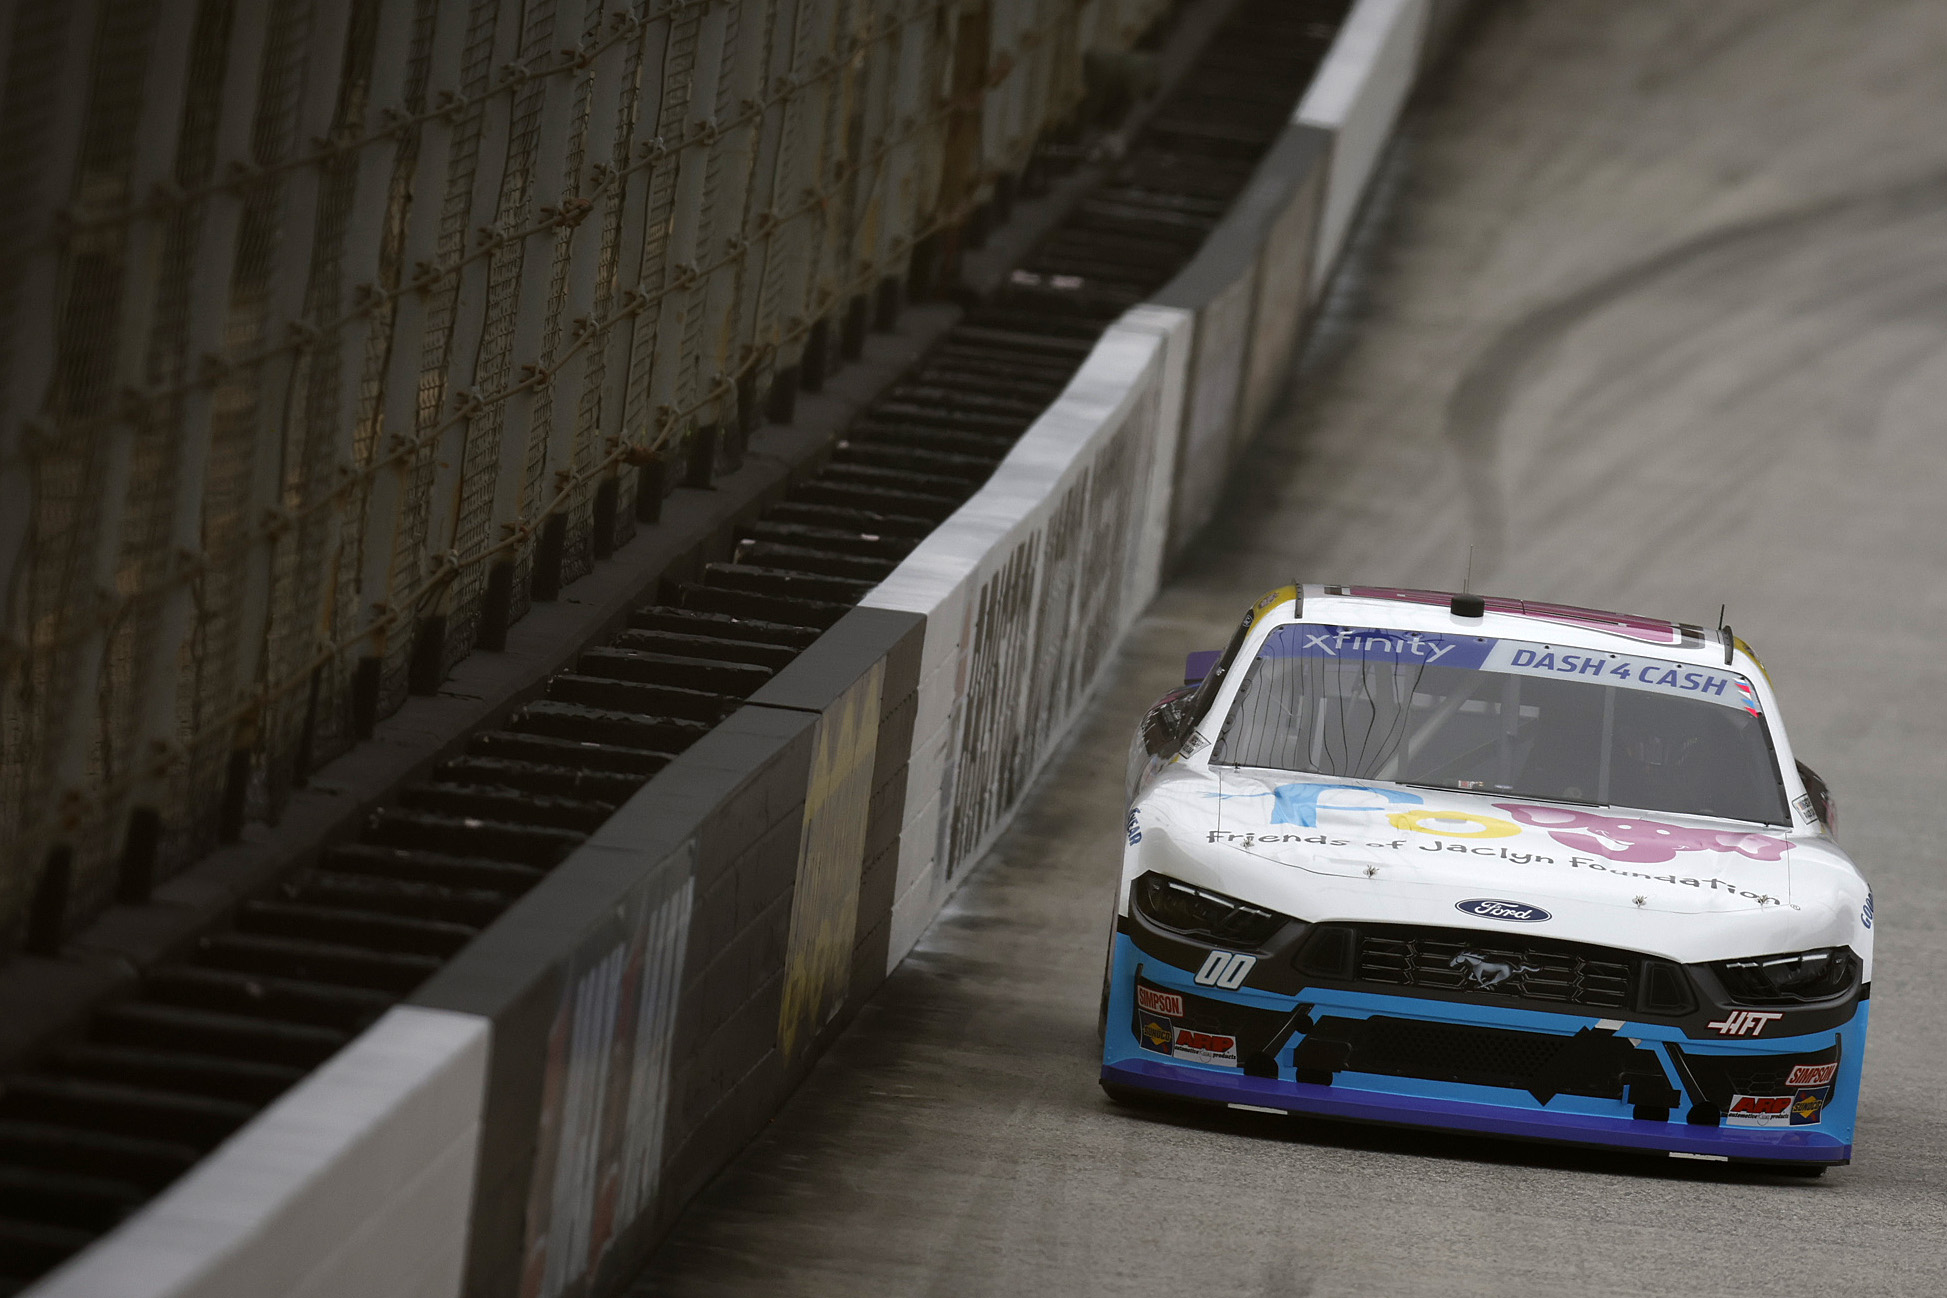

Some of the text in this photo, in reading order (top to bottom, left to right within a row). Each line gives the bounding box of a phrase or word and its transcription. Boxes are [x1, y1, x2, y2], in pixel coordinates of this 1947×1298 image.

[1303, 631, 1456, 663] xfinity
[1510, 648, 1728, 696] DASH 4 CASH
[1206, 830, 1781, 906] Friends of Jaclyn Foundation
[1474, 901, 1533, 919] Ford
[1194, 950, 1257, 990] 00
[1139, 987, 1180, 1015] SIMPSON
[1144, 1025, 1171, 1041] SUNOCO
[1176, 1029, 1234, 1052] ARP
[1789, 1065, 1835, 1084] SIMPSON
[1731, 1097, 1791, 1113] ARP
[1793, 1100, 1821, 1112] SUNOCO
